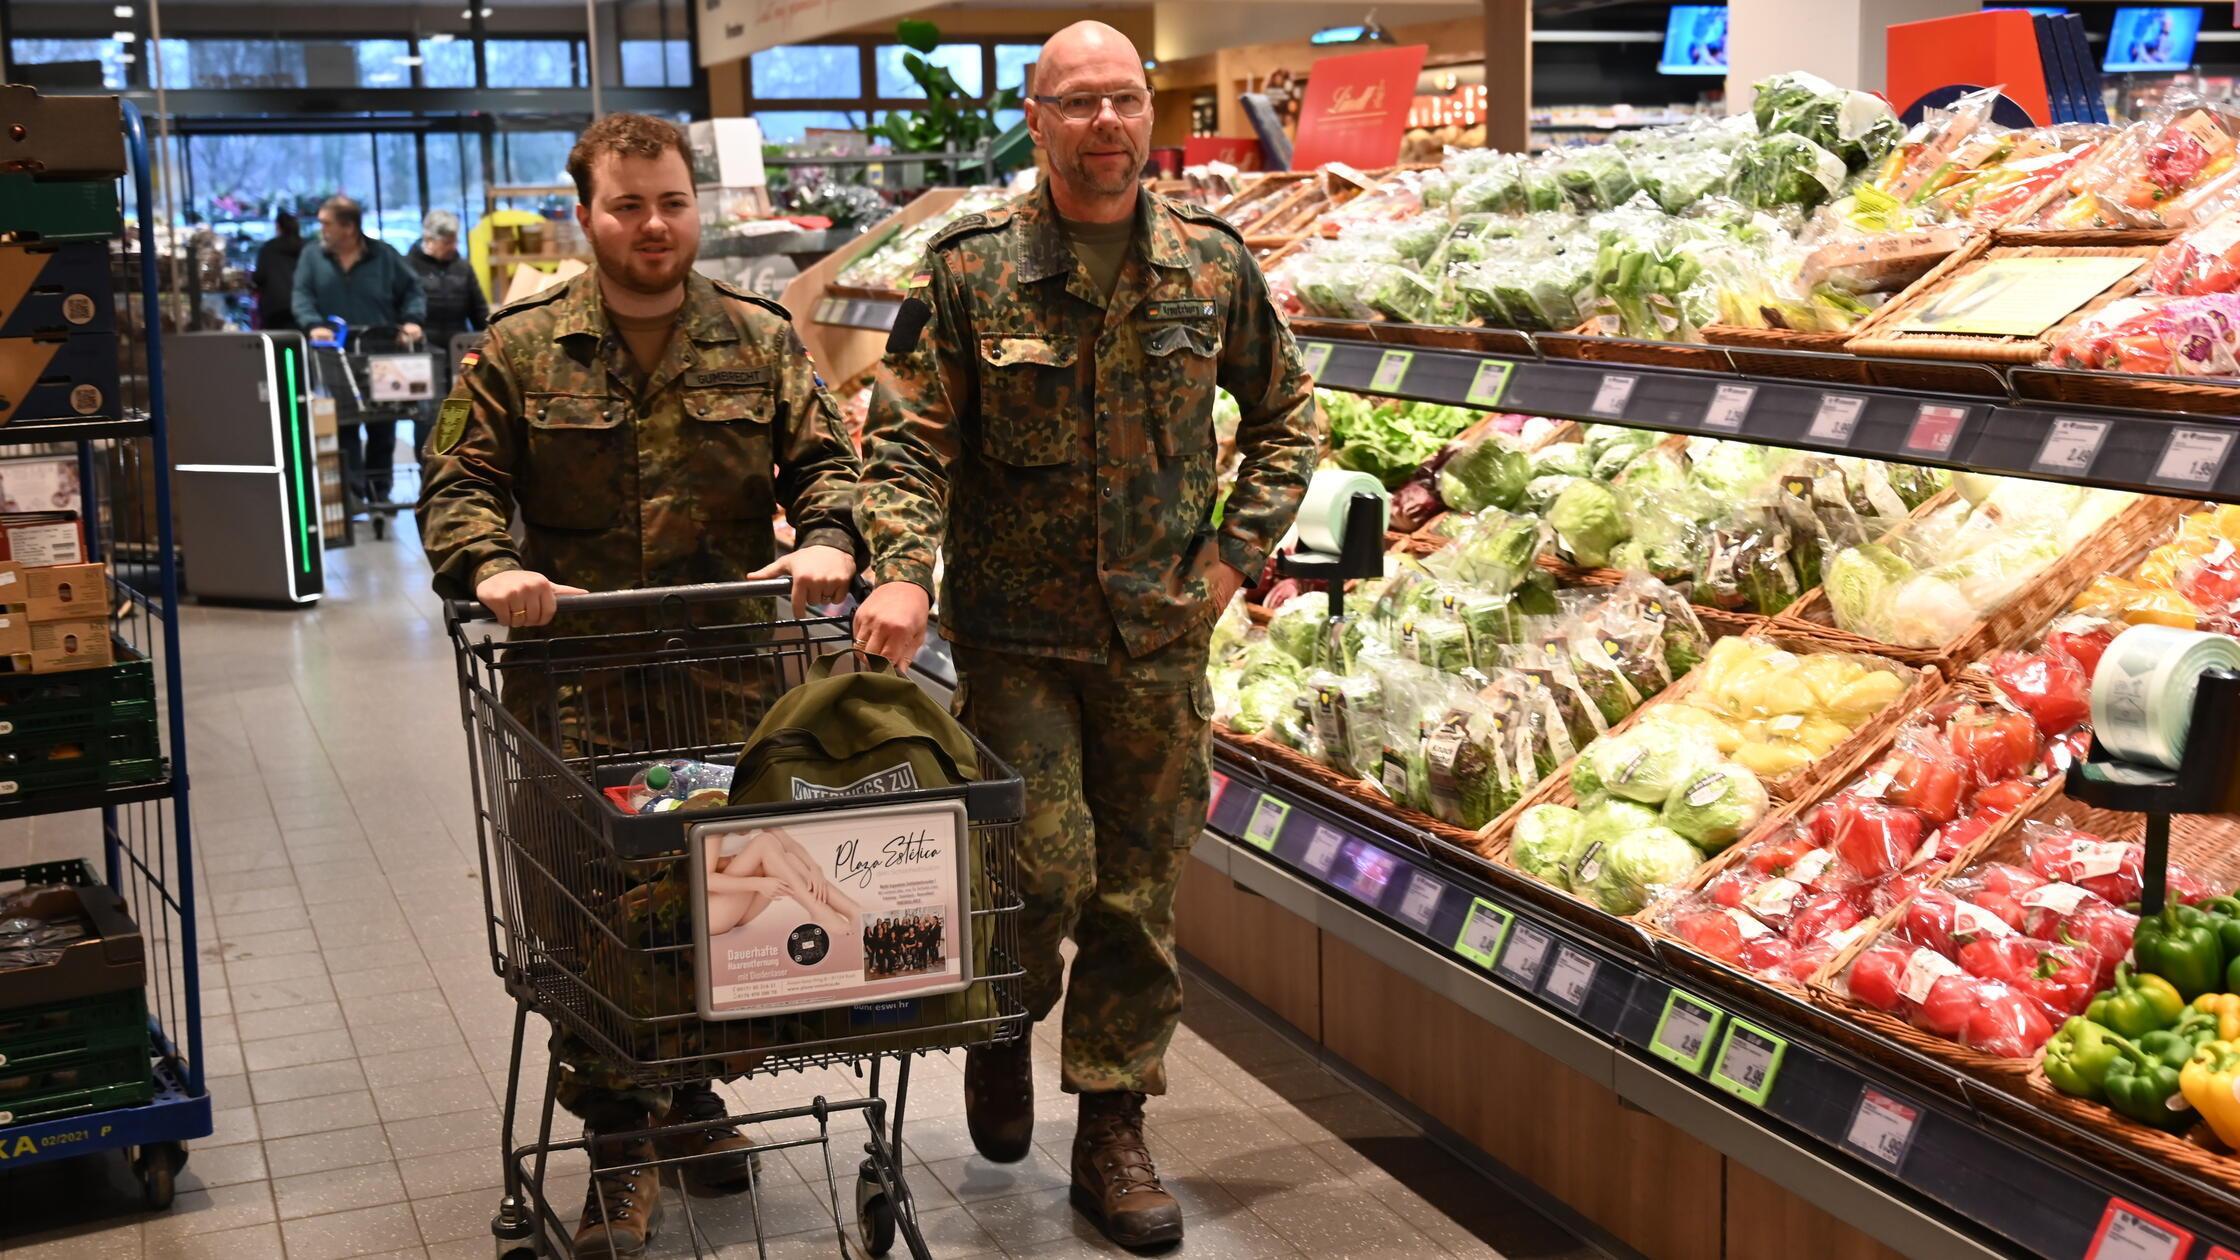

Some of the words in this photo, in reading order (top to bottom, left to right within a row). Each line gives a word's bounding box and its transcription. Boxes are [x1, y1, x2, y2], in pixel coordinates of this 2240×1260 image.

[697, 370, 761, 384] GUMBRECHT
[888, 769, 912, 792] ZU
[834, 838, 882, 889] Plaza
[727, 946, 779, 961] Dauerhafte
[41, 1130, 89, 1146] 02/2021
[101, 1125, 112, 1137] P
